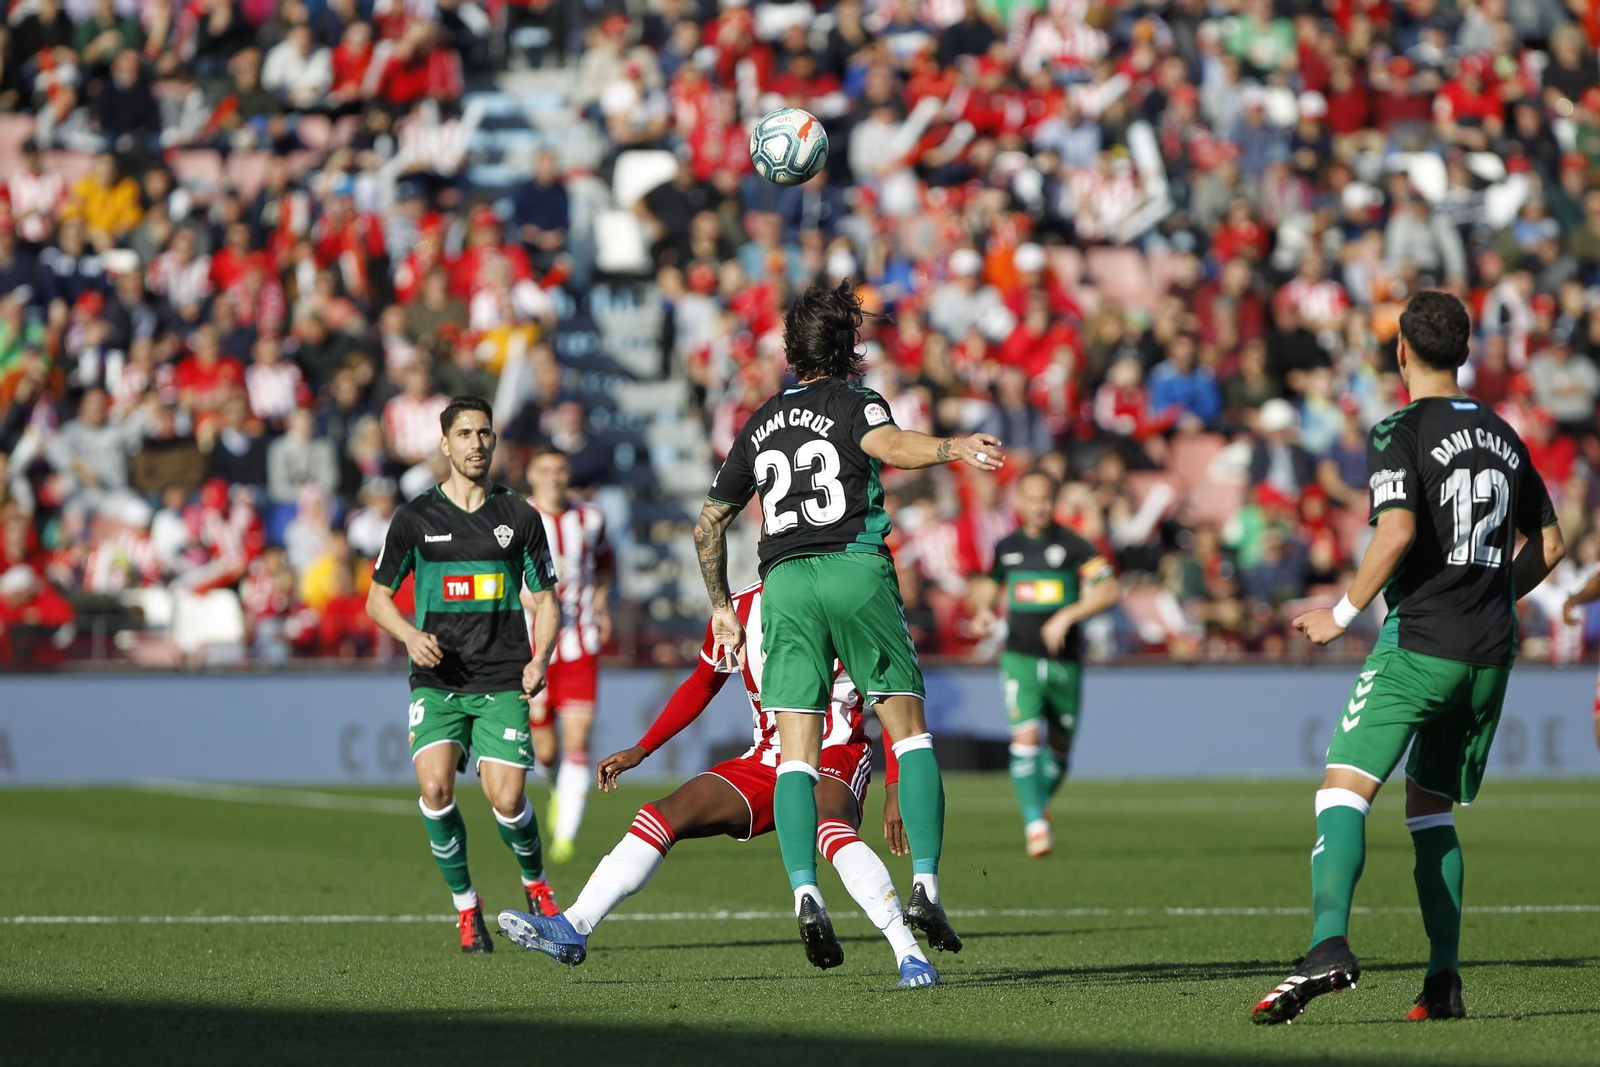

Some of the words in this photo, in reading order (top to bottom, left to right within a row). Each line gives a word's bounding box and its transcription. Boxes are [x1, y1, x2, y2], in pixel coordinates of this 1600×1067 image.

[751, 411, 785, 451] JUAN
[789, 408, 835, 438] CRUZ
[1430, 429, 1473, 467] DANI
[1475, 427, 1520, 470] CALVO
[754, 440, 846, 536] 23
[1374, 480, 1406, 508] HILL
[1439, 468, 1509, 568] 12
[446, 581, 470, 596] TM
